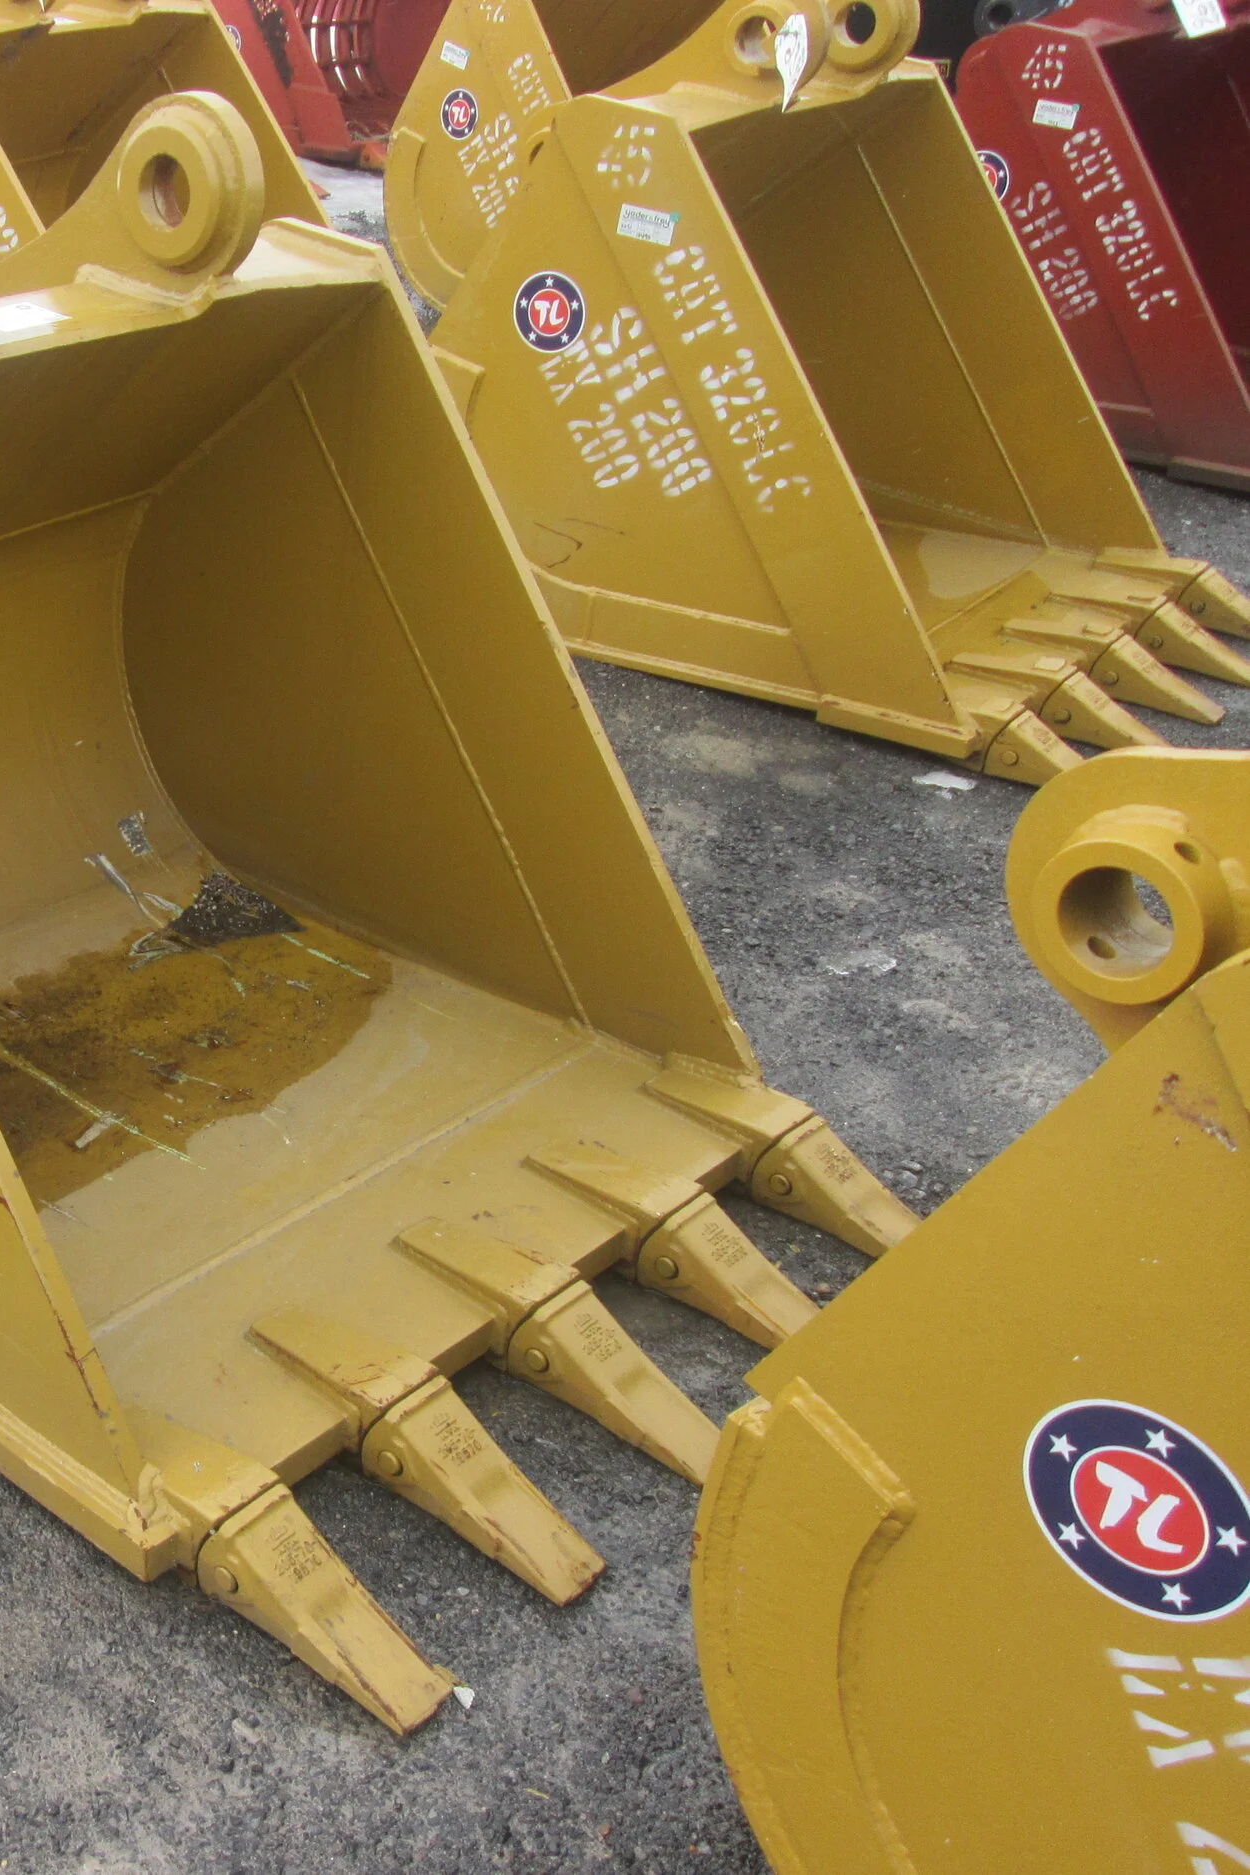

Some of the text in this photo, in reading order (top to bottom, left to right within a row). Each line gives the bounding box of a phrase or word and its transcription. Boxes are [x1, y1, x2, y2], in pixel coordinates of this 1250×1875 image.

[1011, 180, 1068, 250] SH
[1062, 127, 1125, 201] CAT
[1095, 200, 1154, 272] 320
[652, 245, 739, 344] CAT
[699, 347, 783, 446] 320
[1038, 247, 1100, 321] 200
[537, 337, 640, 489] EX 200
[589, 304, 712, 498] SH 200
